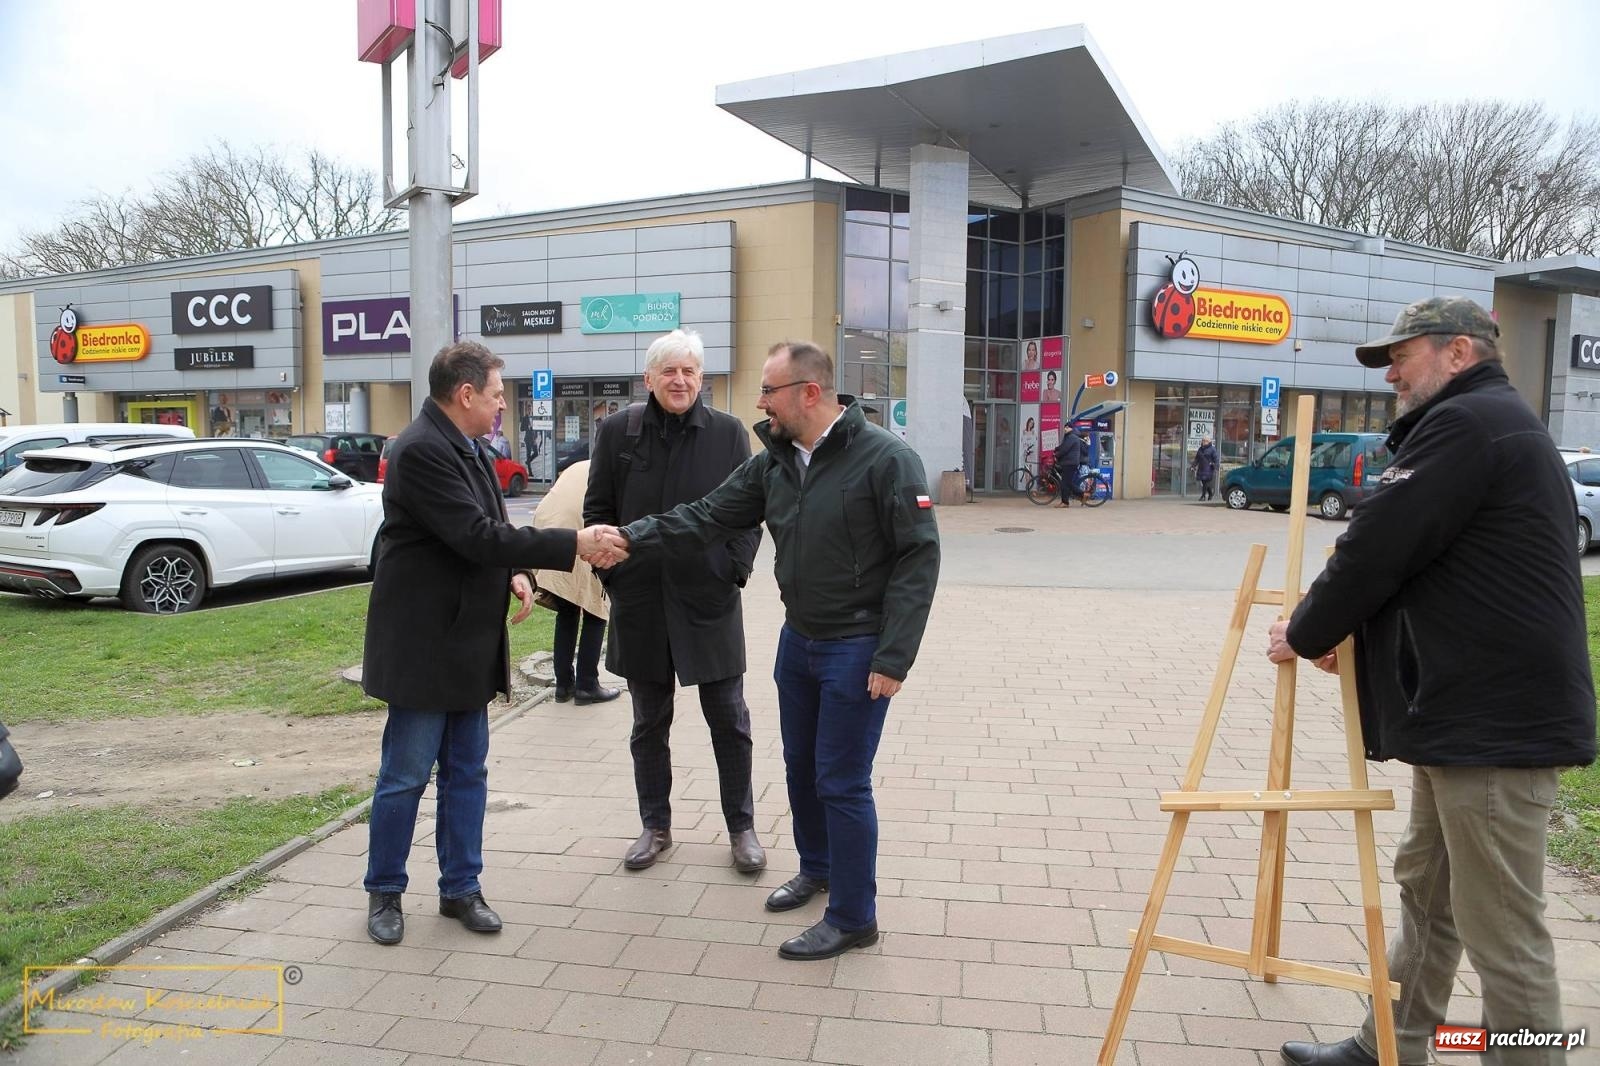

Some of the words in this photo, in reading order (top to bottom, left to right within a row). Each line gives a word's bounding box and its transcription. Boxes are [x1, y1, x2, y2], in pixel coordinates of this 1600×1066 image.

[187, 293, 252, 327] CCC
[647, 302, 675, 312] BIURO
[1197, 297, 1283, 323] Biedronka
[332, 310, 412, 342] PLA
[523, 317, 555, 328] MĘSKIEJ
[1196, 318, 1240, 331] Codziennie
[1241, 321, 1264, 333] niskie
[1265, 326, 1283, 336] ceny
[82, 332, 140, 346] Biedronka
[127, 345, 141, 353] ceny
[1580, 339, 1600, 364] CC
[537, 373, 548, 390] P
[1265, 379, 1277, 399] P
